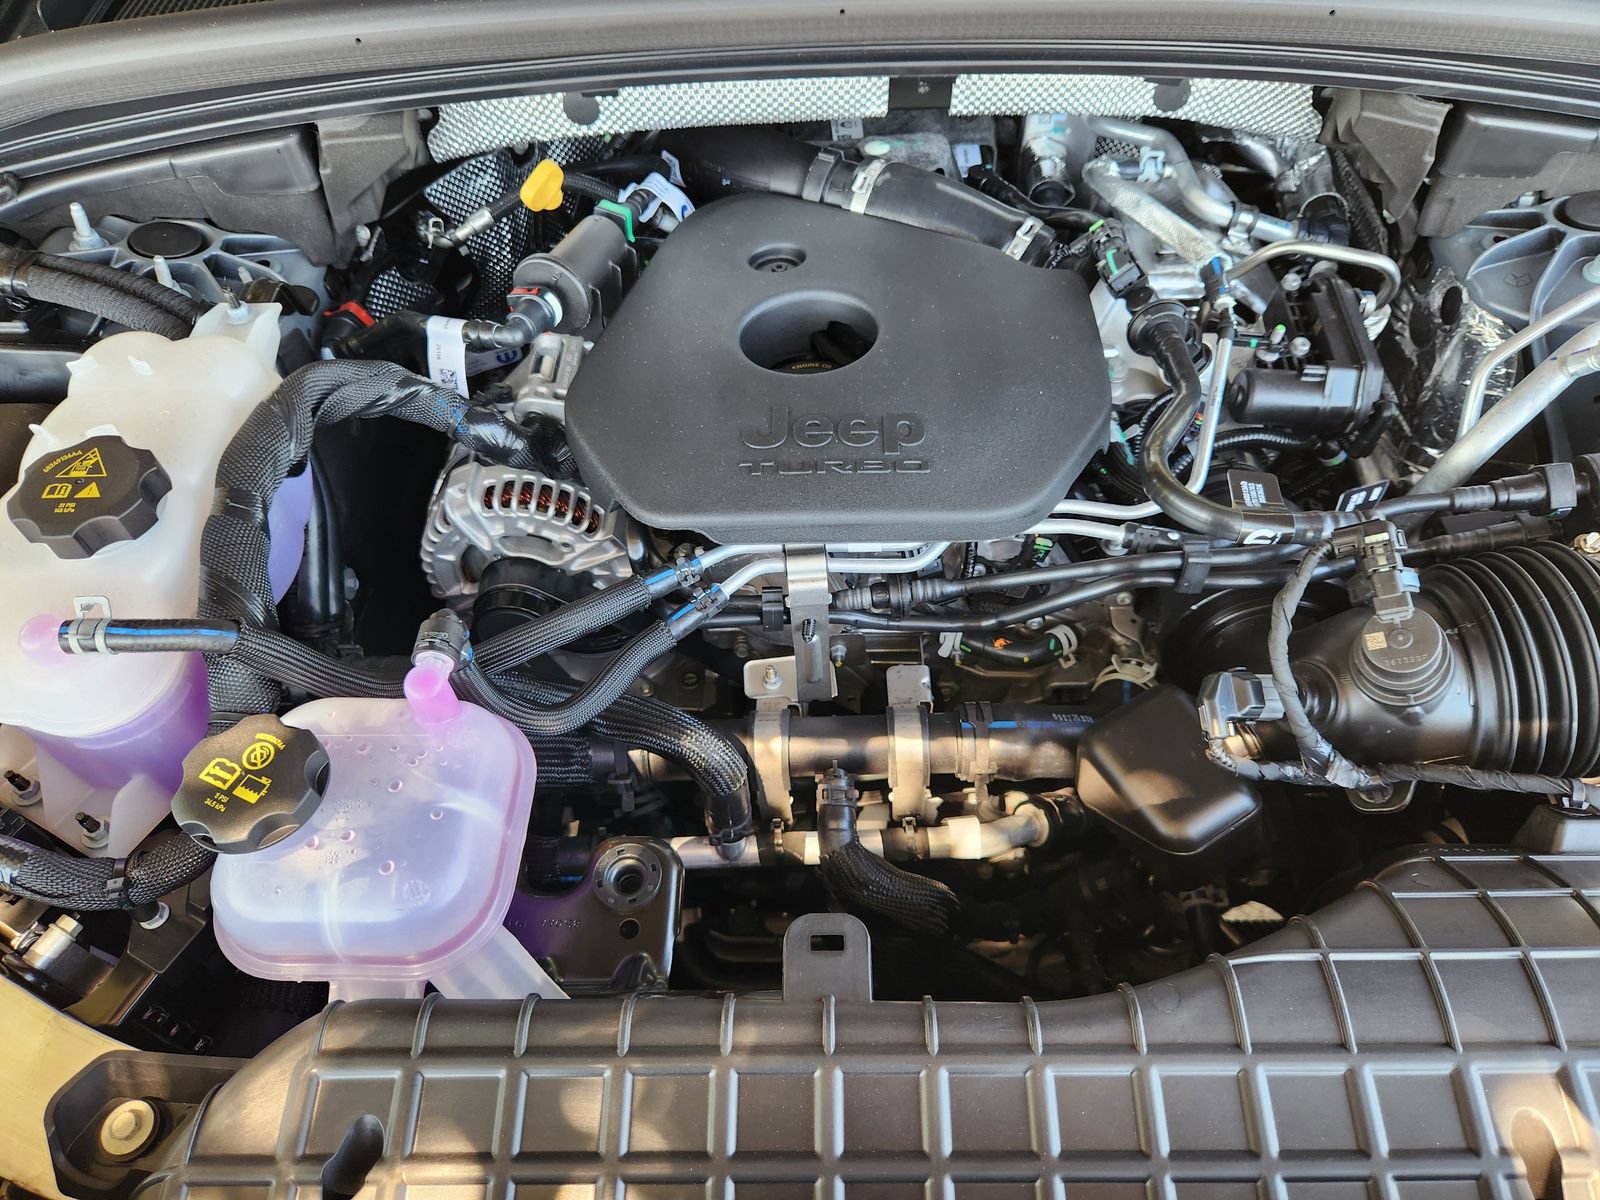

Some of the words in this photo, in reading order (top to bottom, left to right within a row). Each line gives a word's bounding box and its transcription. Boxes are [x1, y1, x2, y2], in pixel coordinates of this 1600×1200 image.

[791, 362, 820, 370] ENGINE
[738, 405, 927, 455] Jeep
[739, 459, 931, 476] TURBO
[204, 797, 216, 807] 34.5
[214, 801, 226, 812] kPa
[218, 794, 230, 802] PSI
